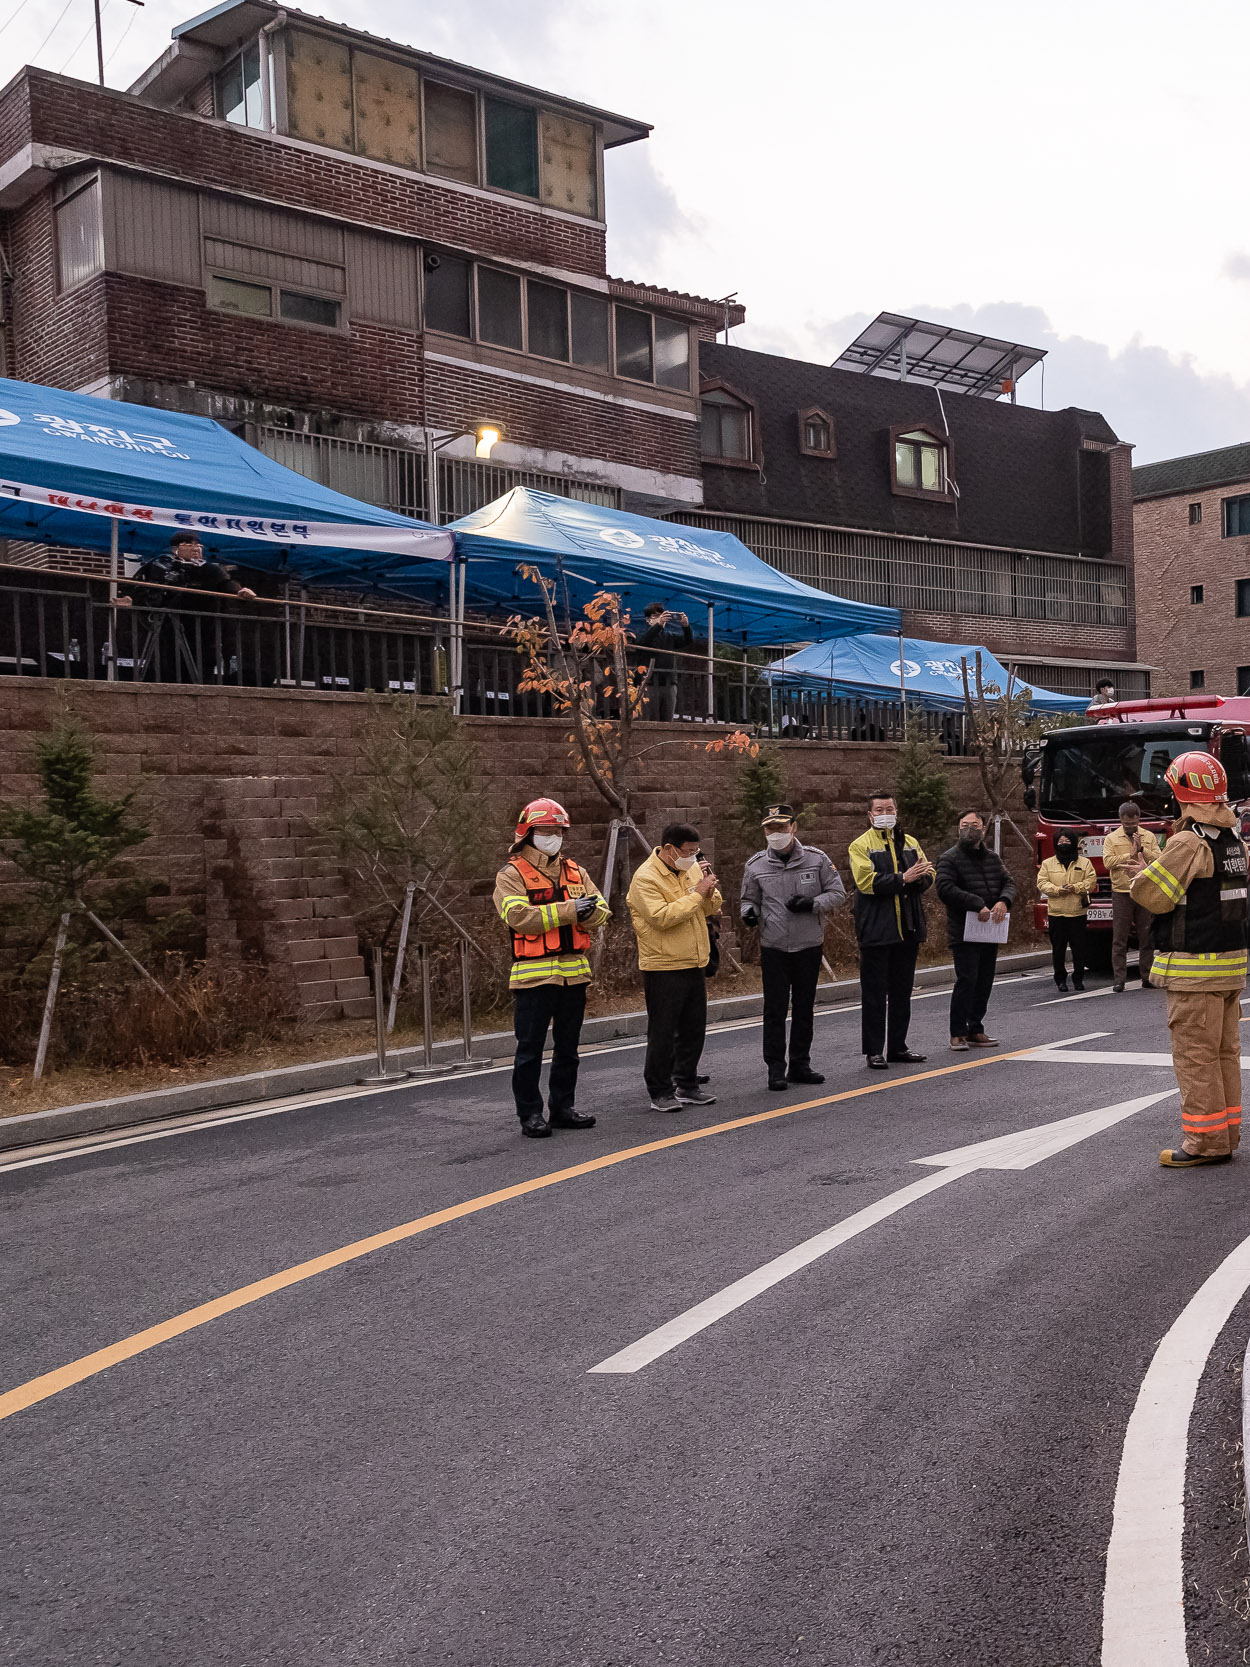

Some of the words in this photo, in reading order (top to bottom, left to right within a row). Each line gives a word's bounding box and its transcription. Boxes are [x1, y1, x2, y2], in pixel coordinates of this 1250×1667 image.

[33, 413, 177, 449] 광진구
[42, 427, 191, 461] GWANGJIN-GU
[647, 534, 725, 560] 광진구
